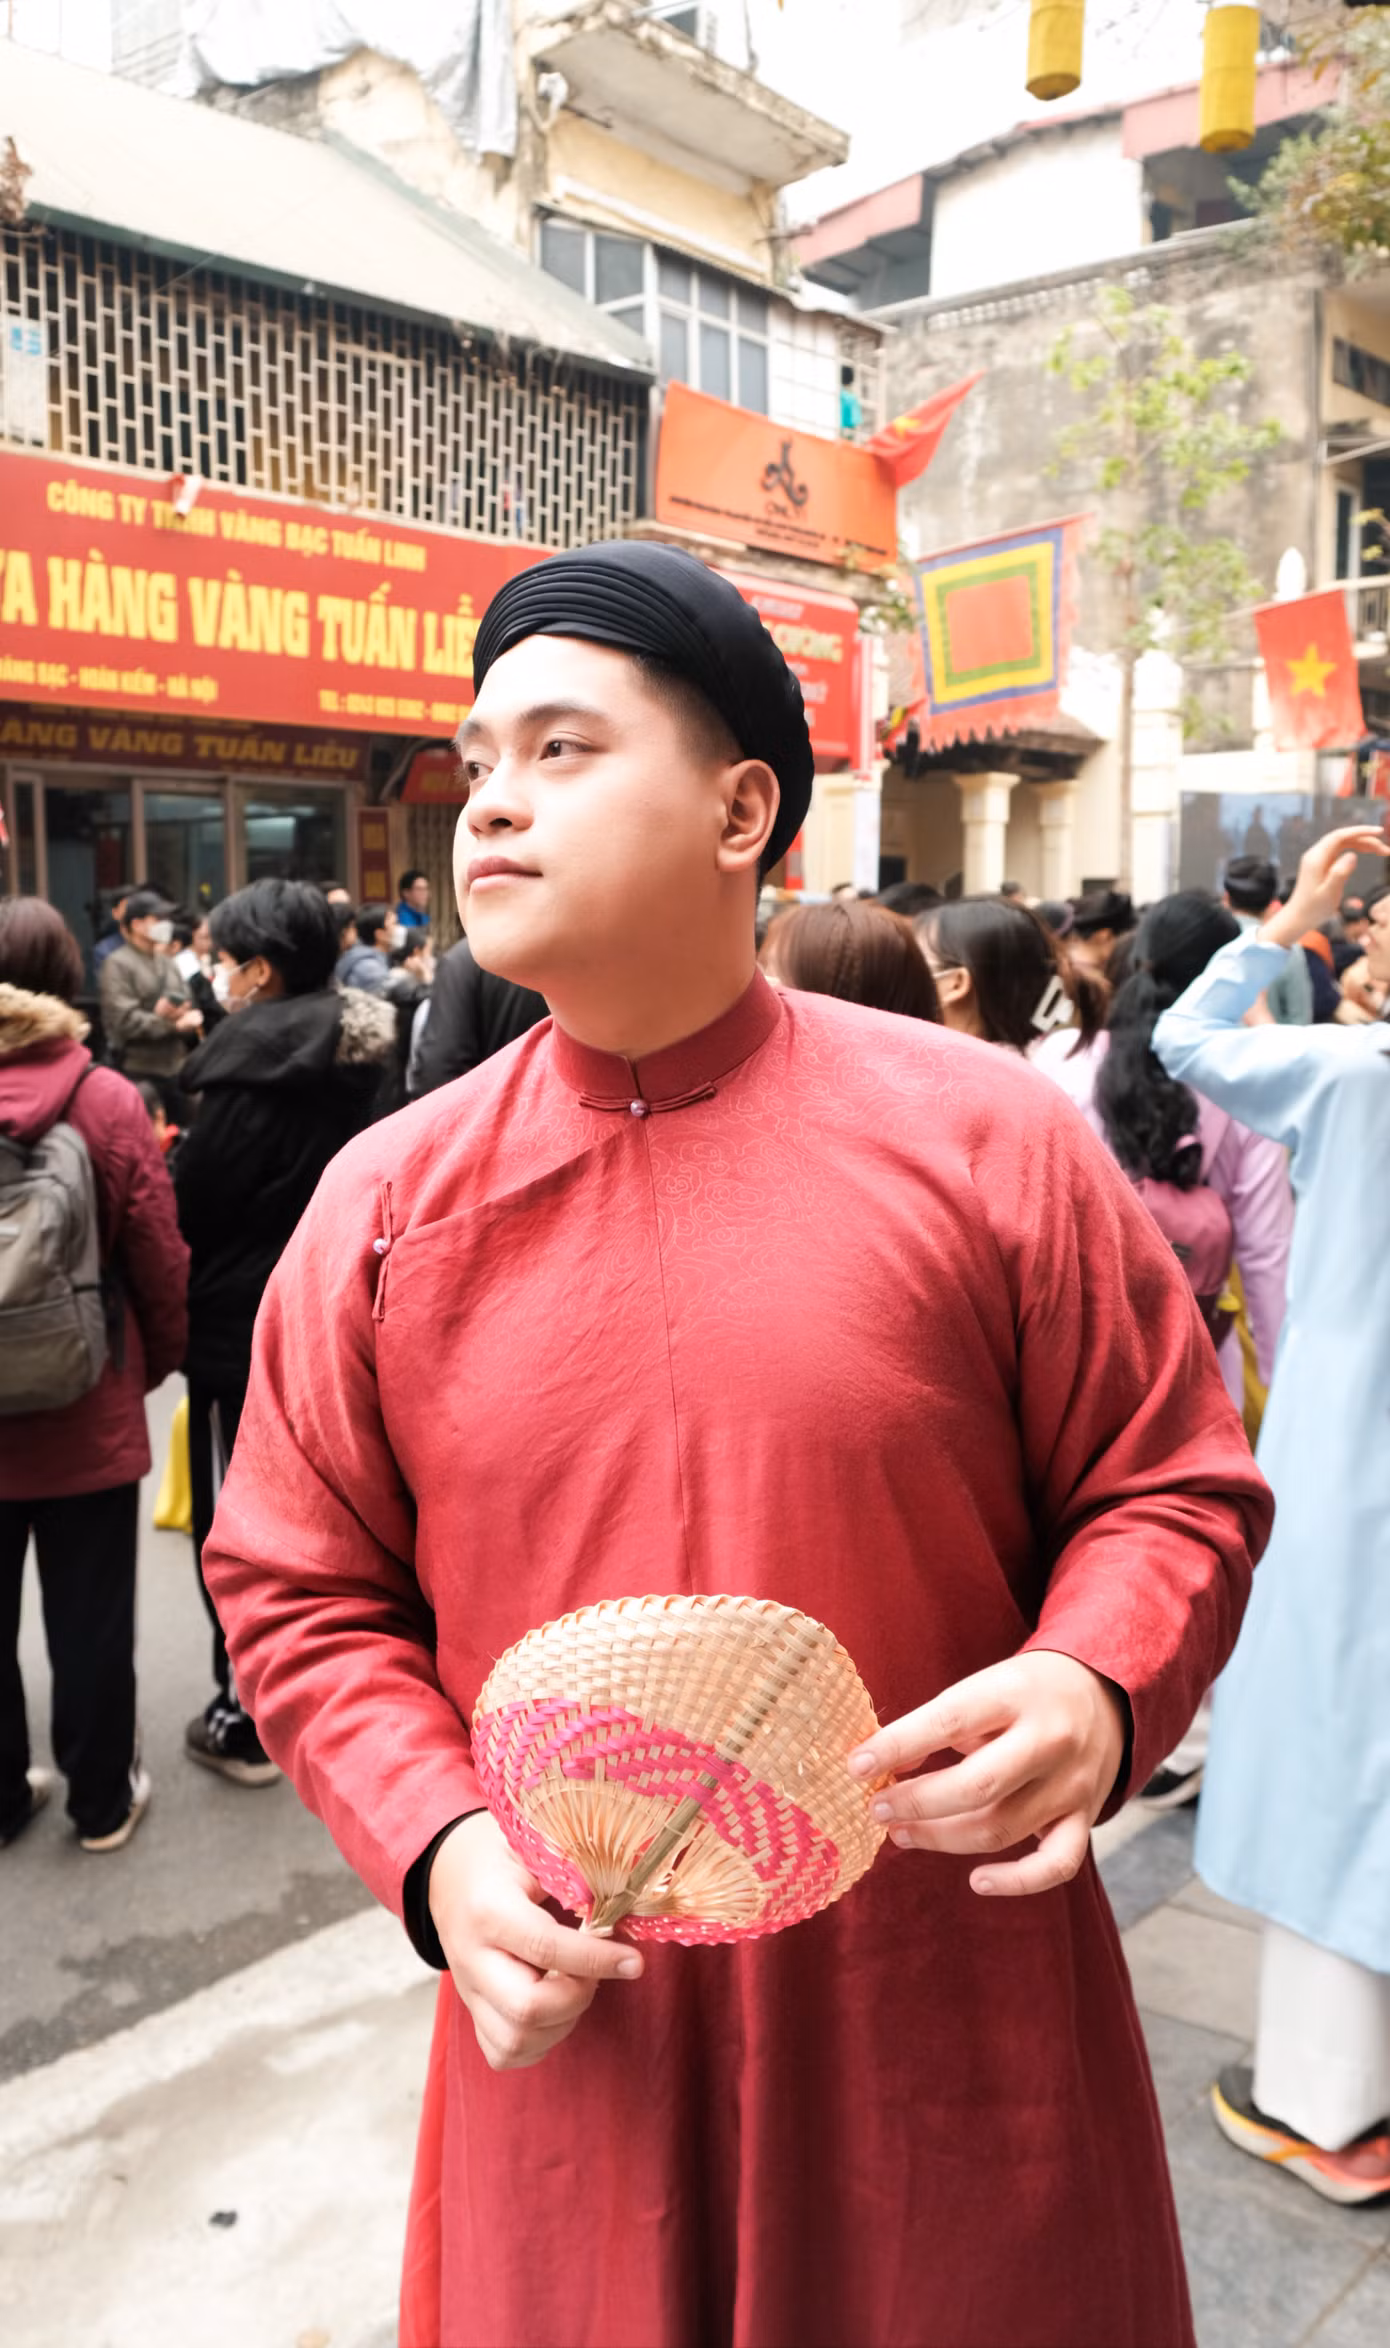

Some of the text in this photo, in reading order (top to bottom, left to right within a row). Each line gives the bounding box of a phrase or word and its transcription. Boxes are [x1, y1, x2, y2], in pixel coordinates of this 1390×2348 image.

[47, 479, 114, 521] CÔNG
[117, 493, 147, 526] TY
[220, 508, 281, 548] VÀNG
[285, 521, 329, 558] BẠC
[0, 550, 38, 627] A
[47, 549, 178, 643] HÀNG
[188, 568, 310, 658] VÀNG
[317, 580, 417, 673] TUẤN
[0, 716, 78, 750] ÀNG
[88, 725, 184, 756] VÀNG
